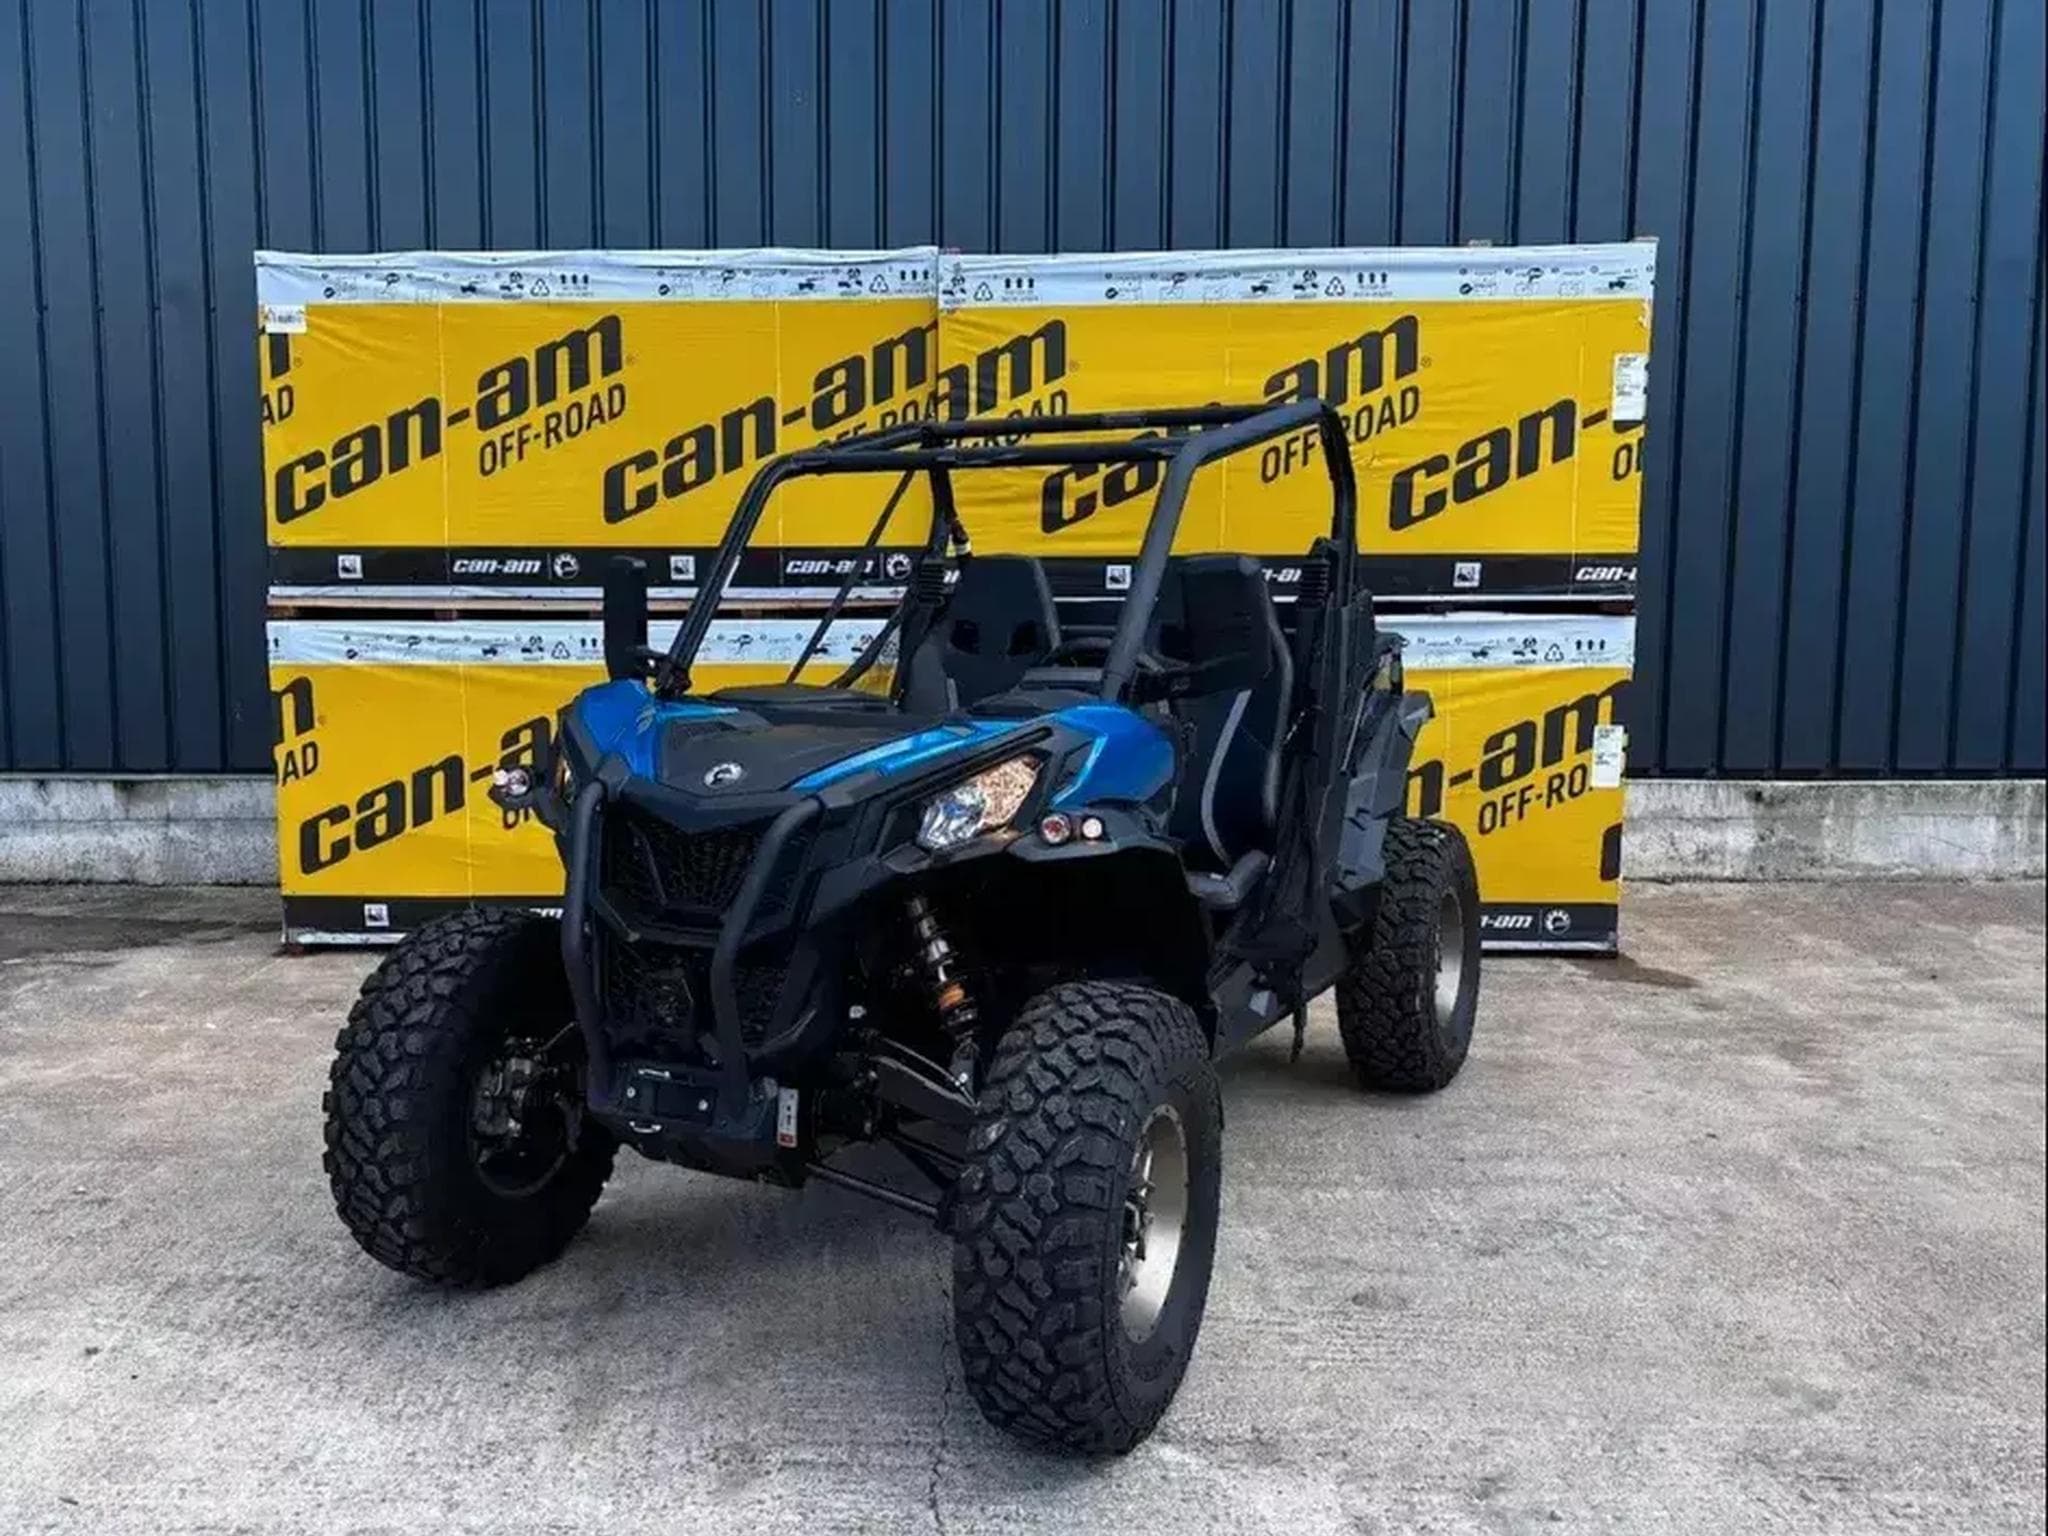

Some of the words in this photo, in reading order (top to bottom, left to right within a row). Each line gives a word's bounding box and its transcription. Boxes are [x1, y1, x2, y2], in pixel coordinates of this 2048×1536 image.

[275, 314, 623, 525] can-am
[479, 383, 626, 477] OFF-ROAD
[453, 558, 541, 574] can-am
[1478, 763, 1594, 836] OFF-RO
